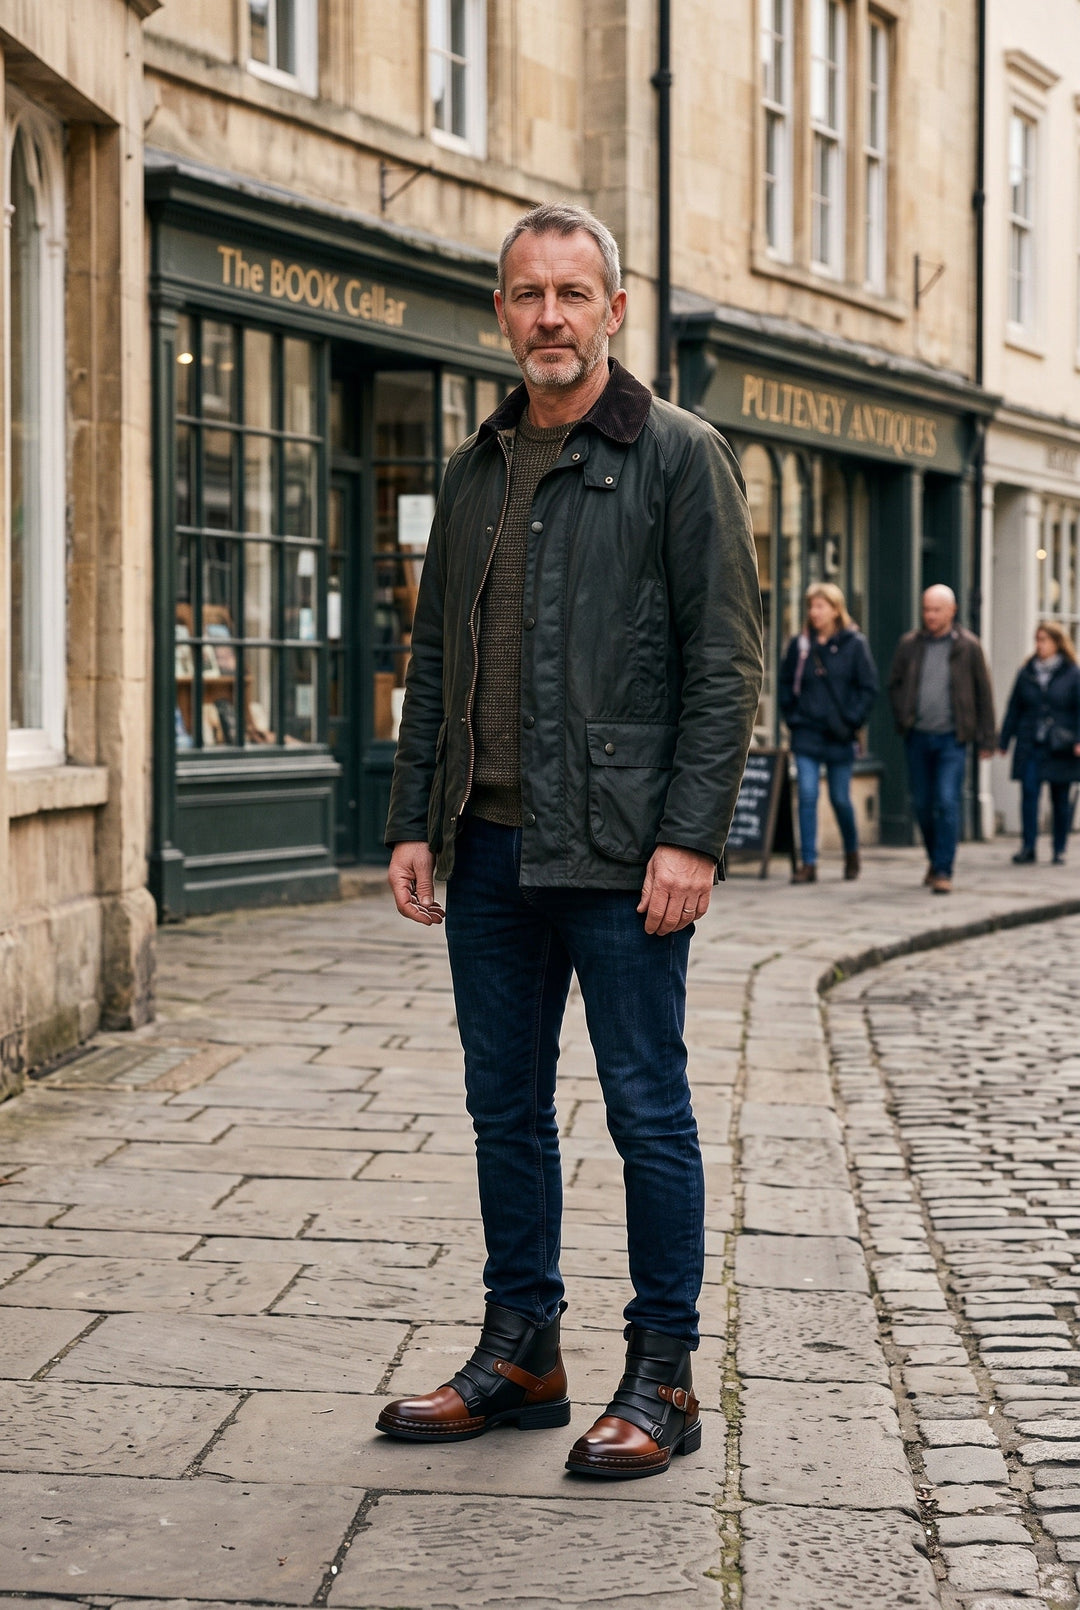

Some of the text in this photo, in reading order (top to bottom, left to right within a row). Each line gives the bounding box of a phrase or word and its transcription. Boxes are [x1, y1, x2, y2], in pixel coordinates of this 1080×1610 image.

[218, 245, 407, 326] The BOOK Cellar
[741, 374, 937, 458] PULTENEY ANTIQUES
